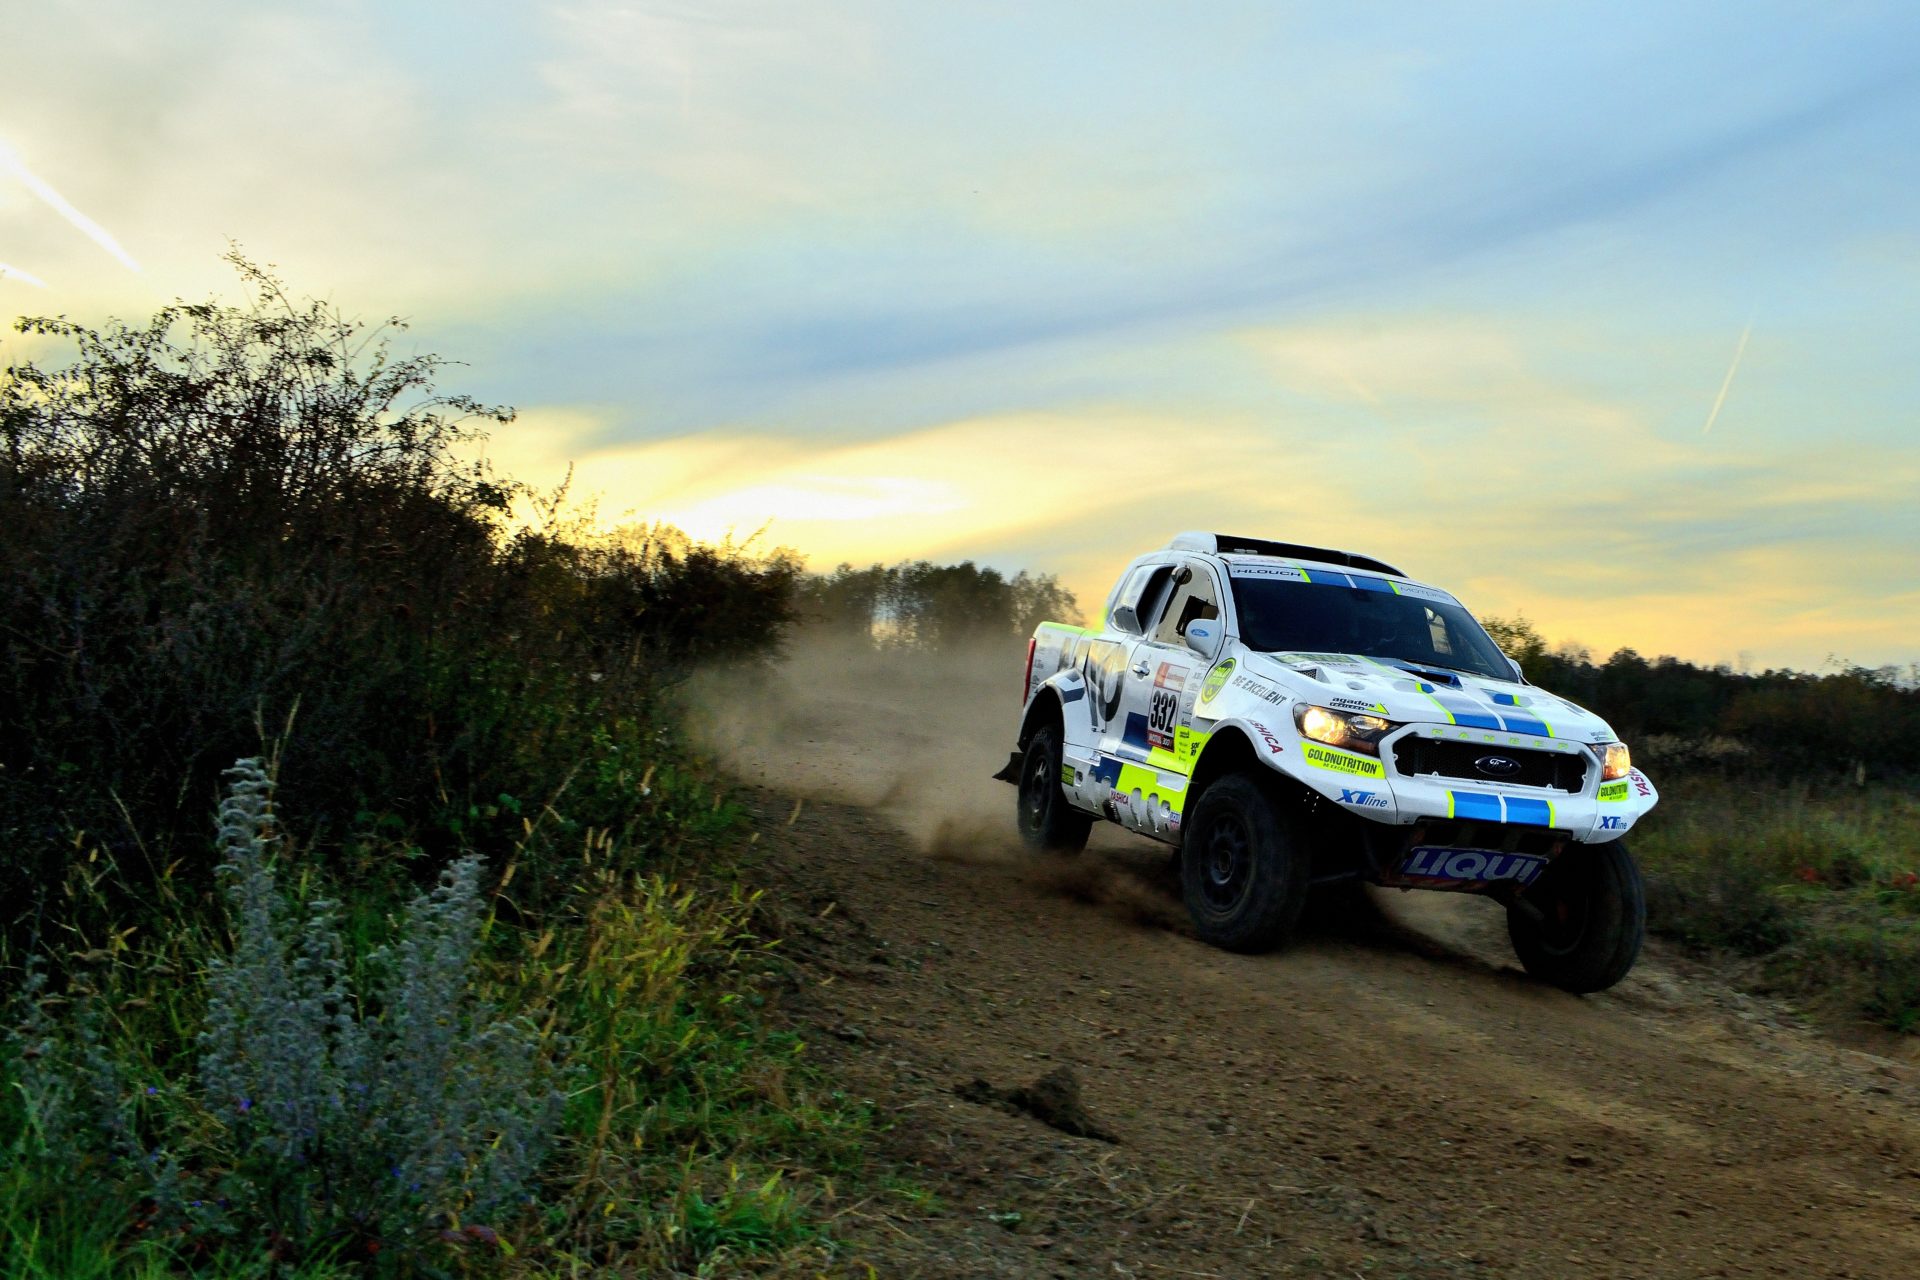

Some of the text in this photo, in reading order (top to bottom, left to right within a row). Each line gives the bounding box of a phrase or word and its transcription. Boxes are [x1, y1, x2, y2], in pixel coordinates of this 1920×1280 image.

[1242, 680, 1287, 706] EXCELLENT
[1150, 690, 1177, 734] 332
[1431, 728, 1569, 750] RANGER
[1307, 748, 1378, 775] GOLDNUTRITION
[1336, 788, 1388, 808] XTline
[1406, 850, 1538, 883] LIQUI
